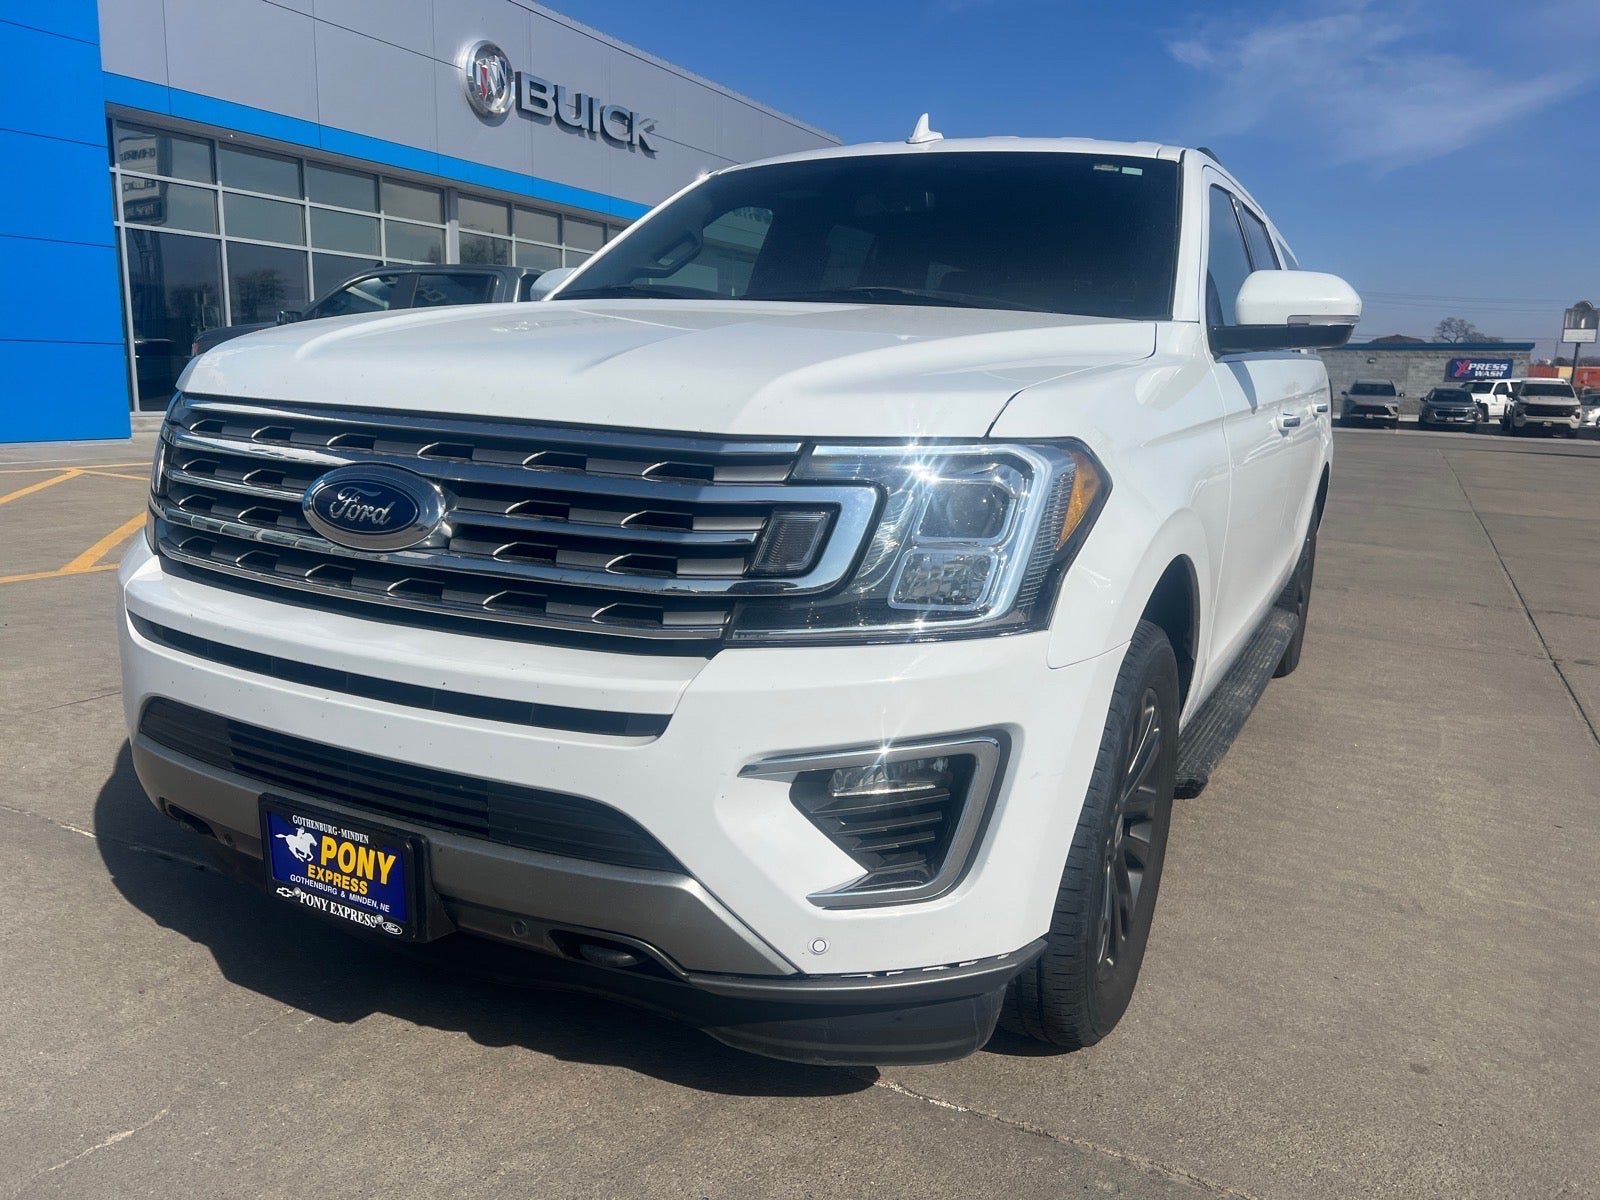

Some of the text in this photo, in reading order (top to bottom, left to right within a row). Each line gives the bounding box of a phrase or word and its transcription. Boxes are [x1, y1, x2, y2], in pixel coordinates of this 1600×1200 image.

[515, 71, 659, 153] BUICK
[1455, 359, 1509, 377] XPRESS
[329, 486, 396, 526] Ford
[307, 864, 368, 895] EXPRESS
[320, 835, 396, 885] PONY
[289, 874, 390, 913] GOTHENBURG & MINDEN, NE
[299, 891, 378, 929] PONY EXPRESS
